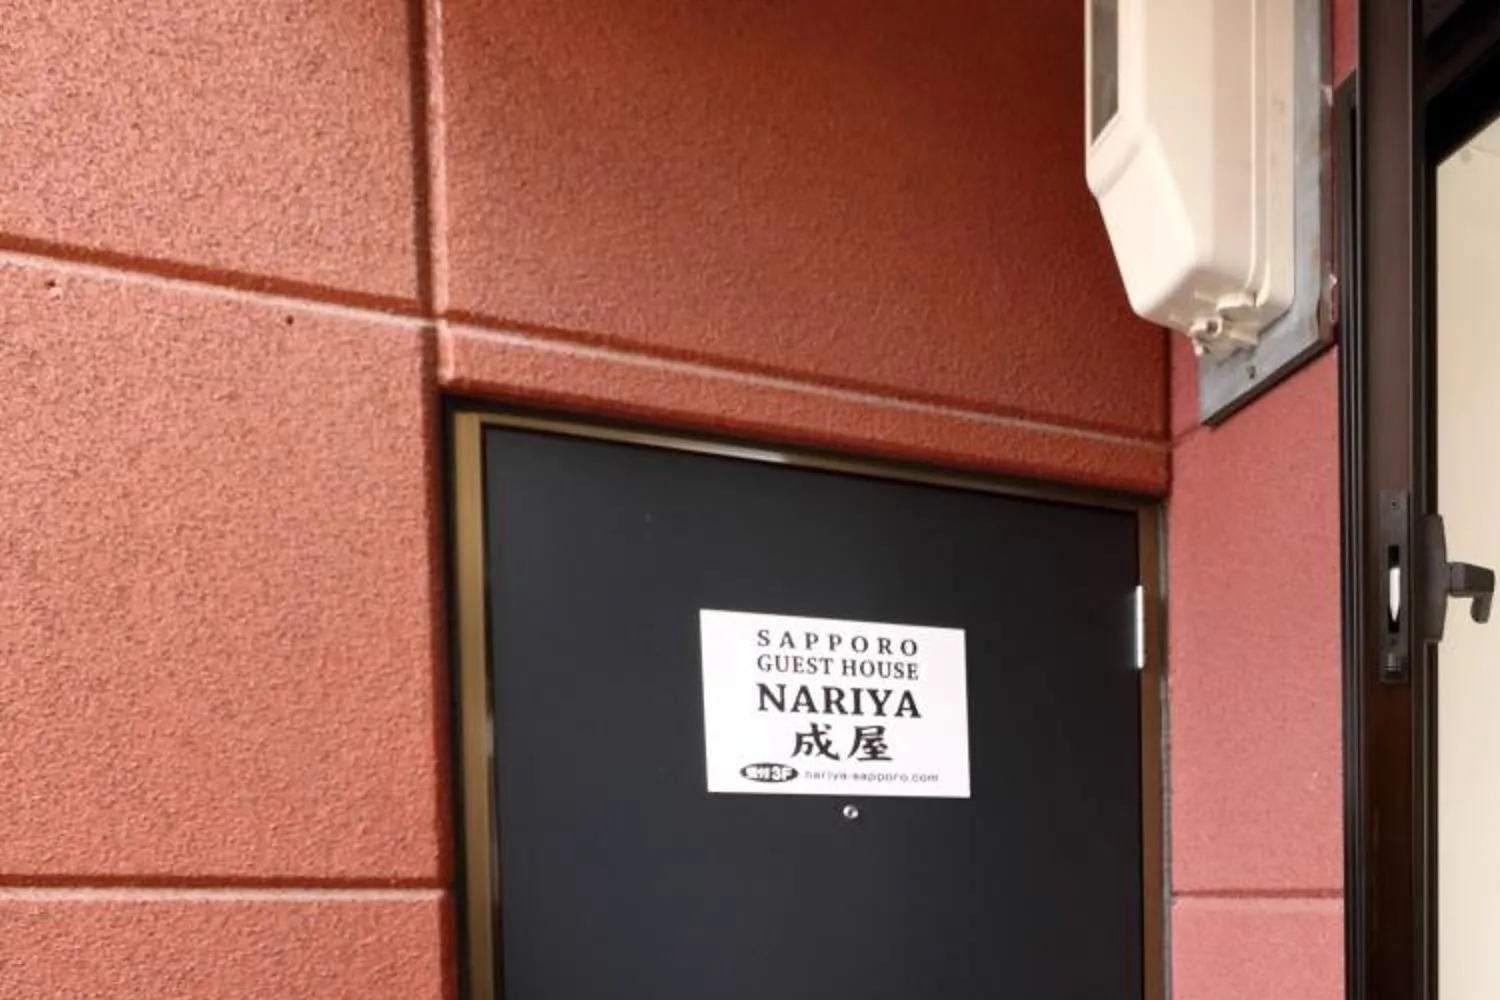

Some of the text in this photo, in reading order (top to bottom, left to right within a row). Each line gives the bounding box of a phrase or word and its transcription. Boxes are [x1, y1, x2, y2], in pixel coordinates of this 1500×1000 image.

[757, 629, 918, 656] SAPPORO
[757, 654, 919, 680] GUEST HOUSE
[757, 683, 922, 719] NARIYA
[791, 722, 893, 762] 成屋
[804, 769, 939, 783] nariya-sapporo.com
